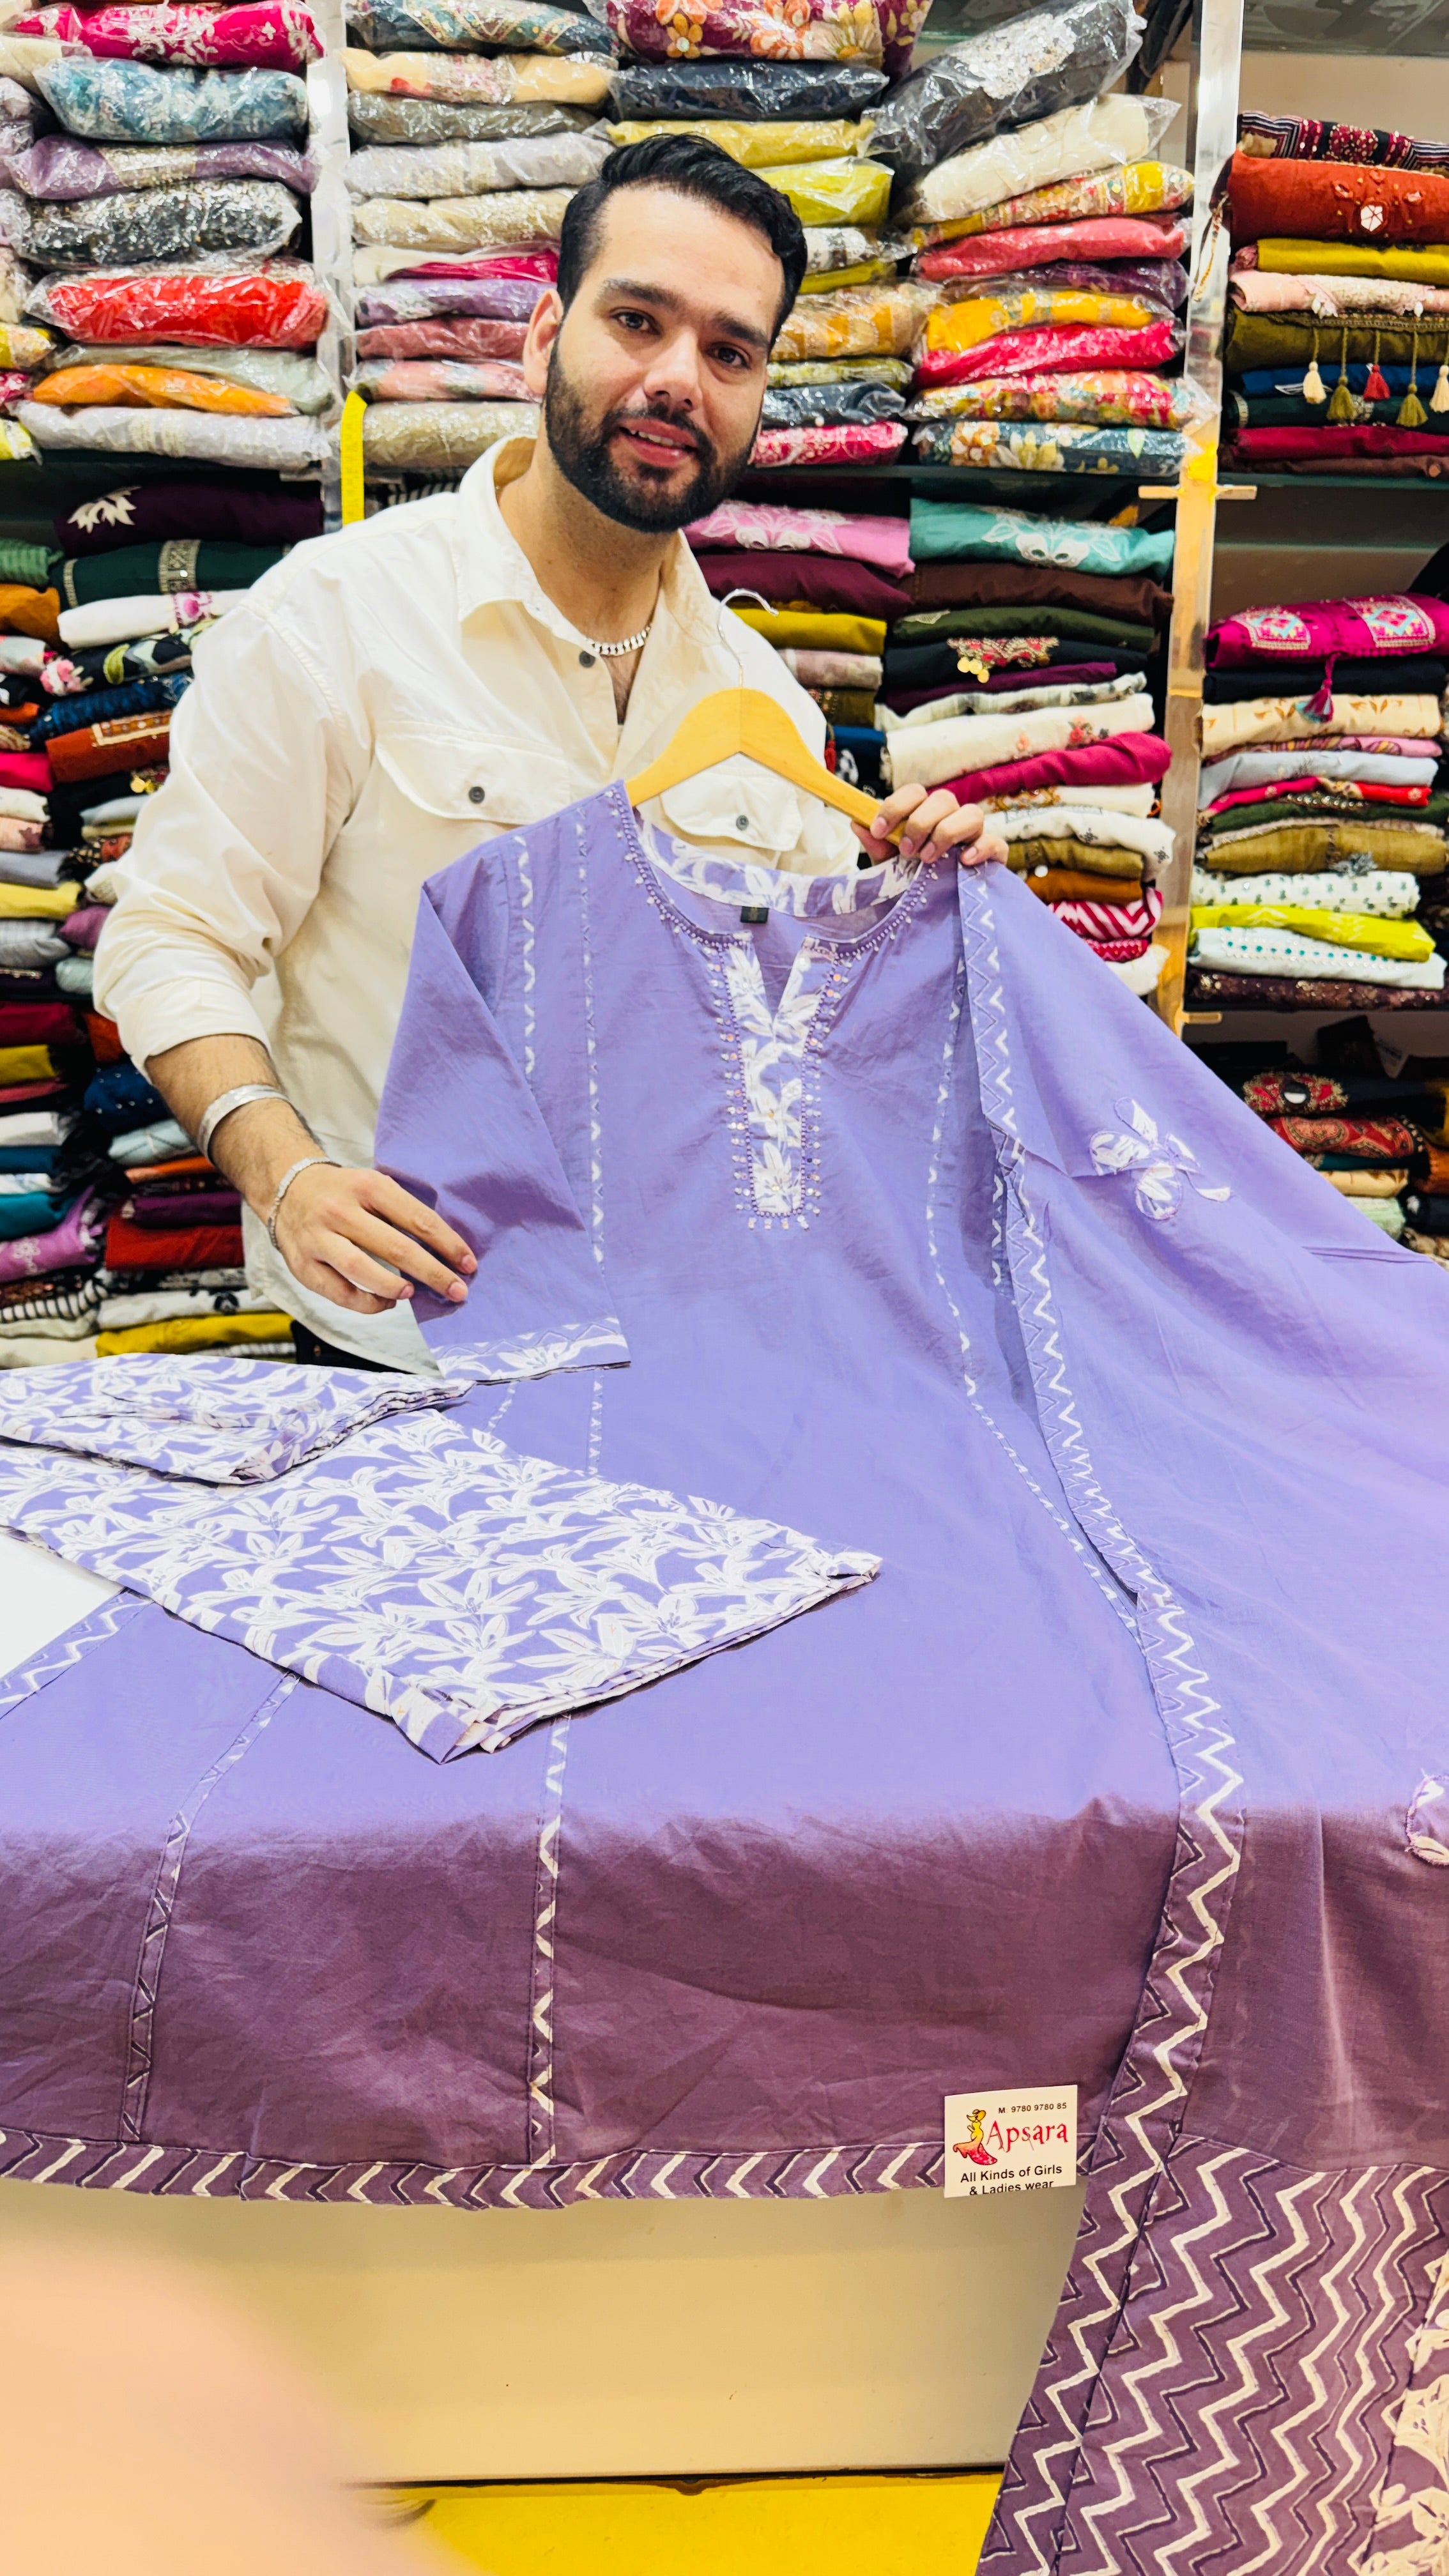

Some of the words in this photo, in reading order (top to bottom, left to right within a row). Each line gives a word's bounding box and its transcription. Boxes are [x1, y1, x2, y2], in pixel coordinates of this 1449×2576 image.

[1011, 2104, 1031, 2113] 9780
[986, 2120, 1068, 2153] Apsara
[960, 2172, 976, 2182] All
[981, 2168, 1015, 2181] Kinds
[1018, 2166, 1031, 2177] of
[1034, 2165, 1062, 2175] Girls
[969, 2186, 978, 2196] &
[982, 2183, 1021, 2195] Ladies
[1025, 2180, 1054, 2191] wear
